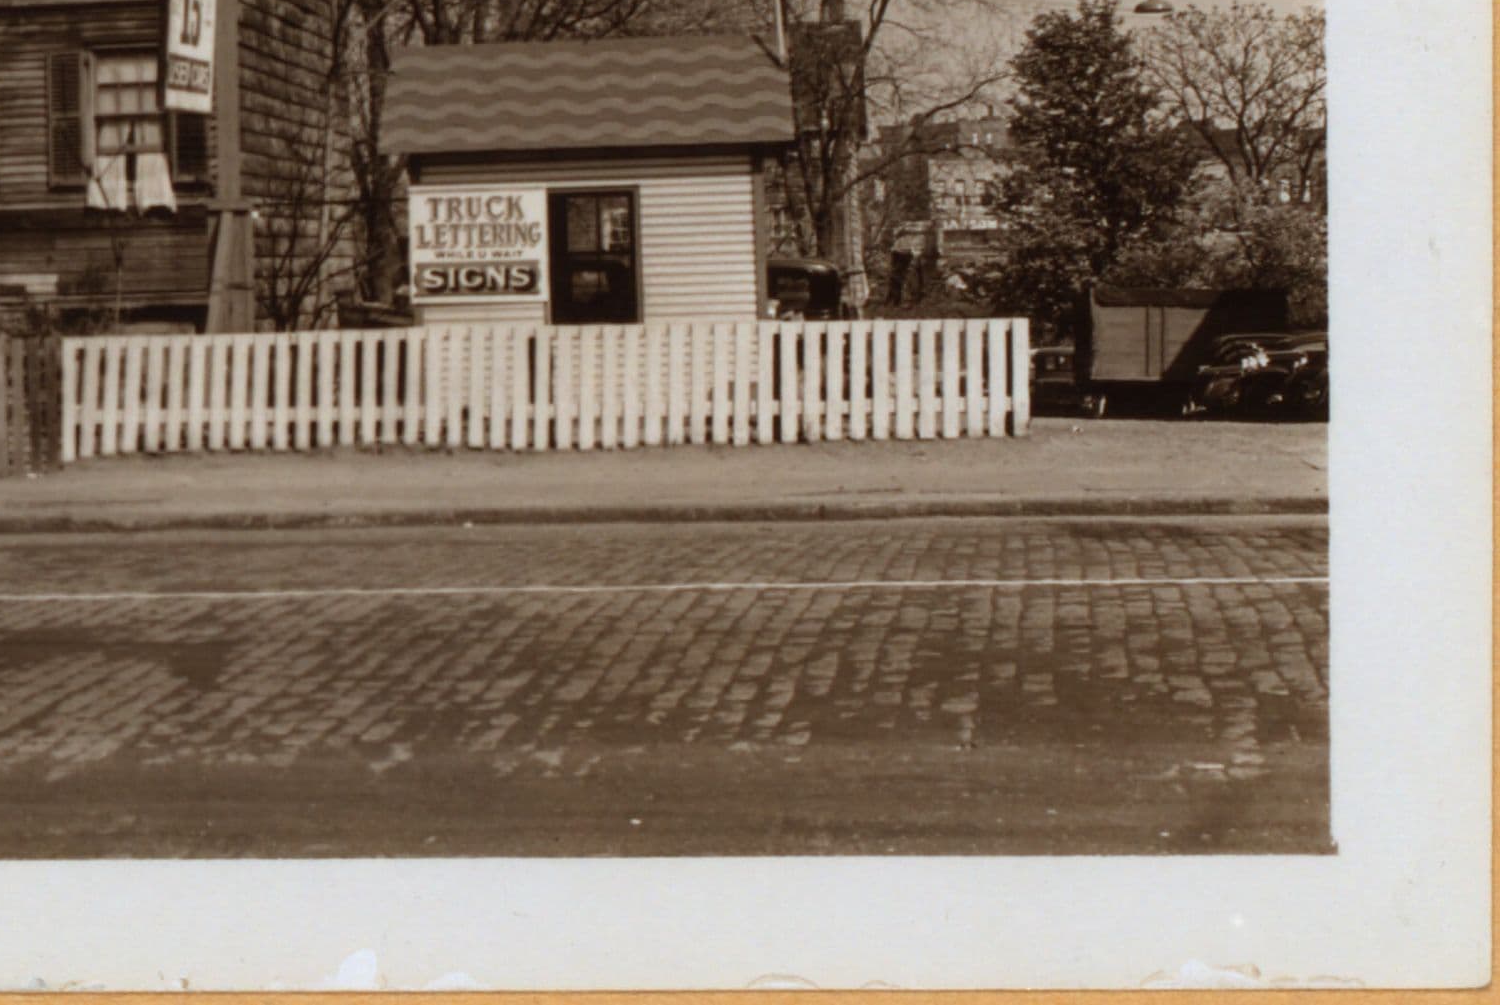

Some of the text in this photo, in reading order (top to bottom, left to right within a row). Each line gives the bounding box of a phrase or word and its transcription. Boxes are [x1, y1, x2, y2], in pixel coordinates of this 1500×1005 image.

[426, 195, 524, 222] TRUCK
[415, 222, 541, 248] LETTERING
[419, 265, 537, 293] SIGNS
